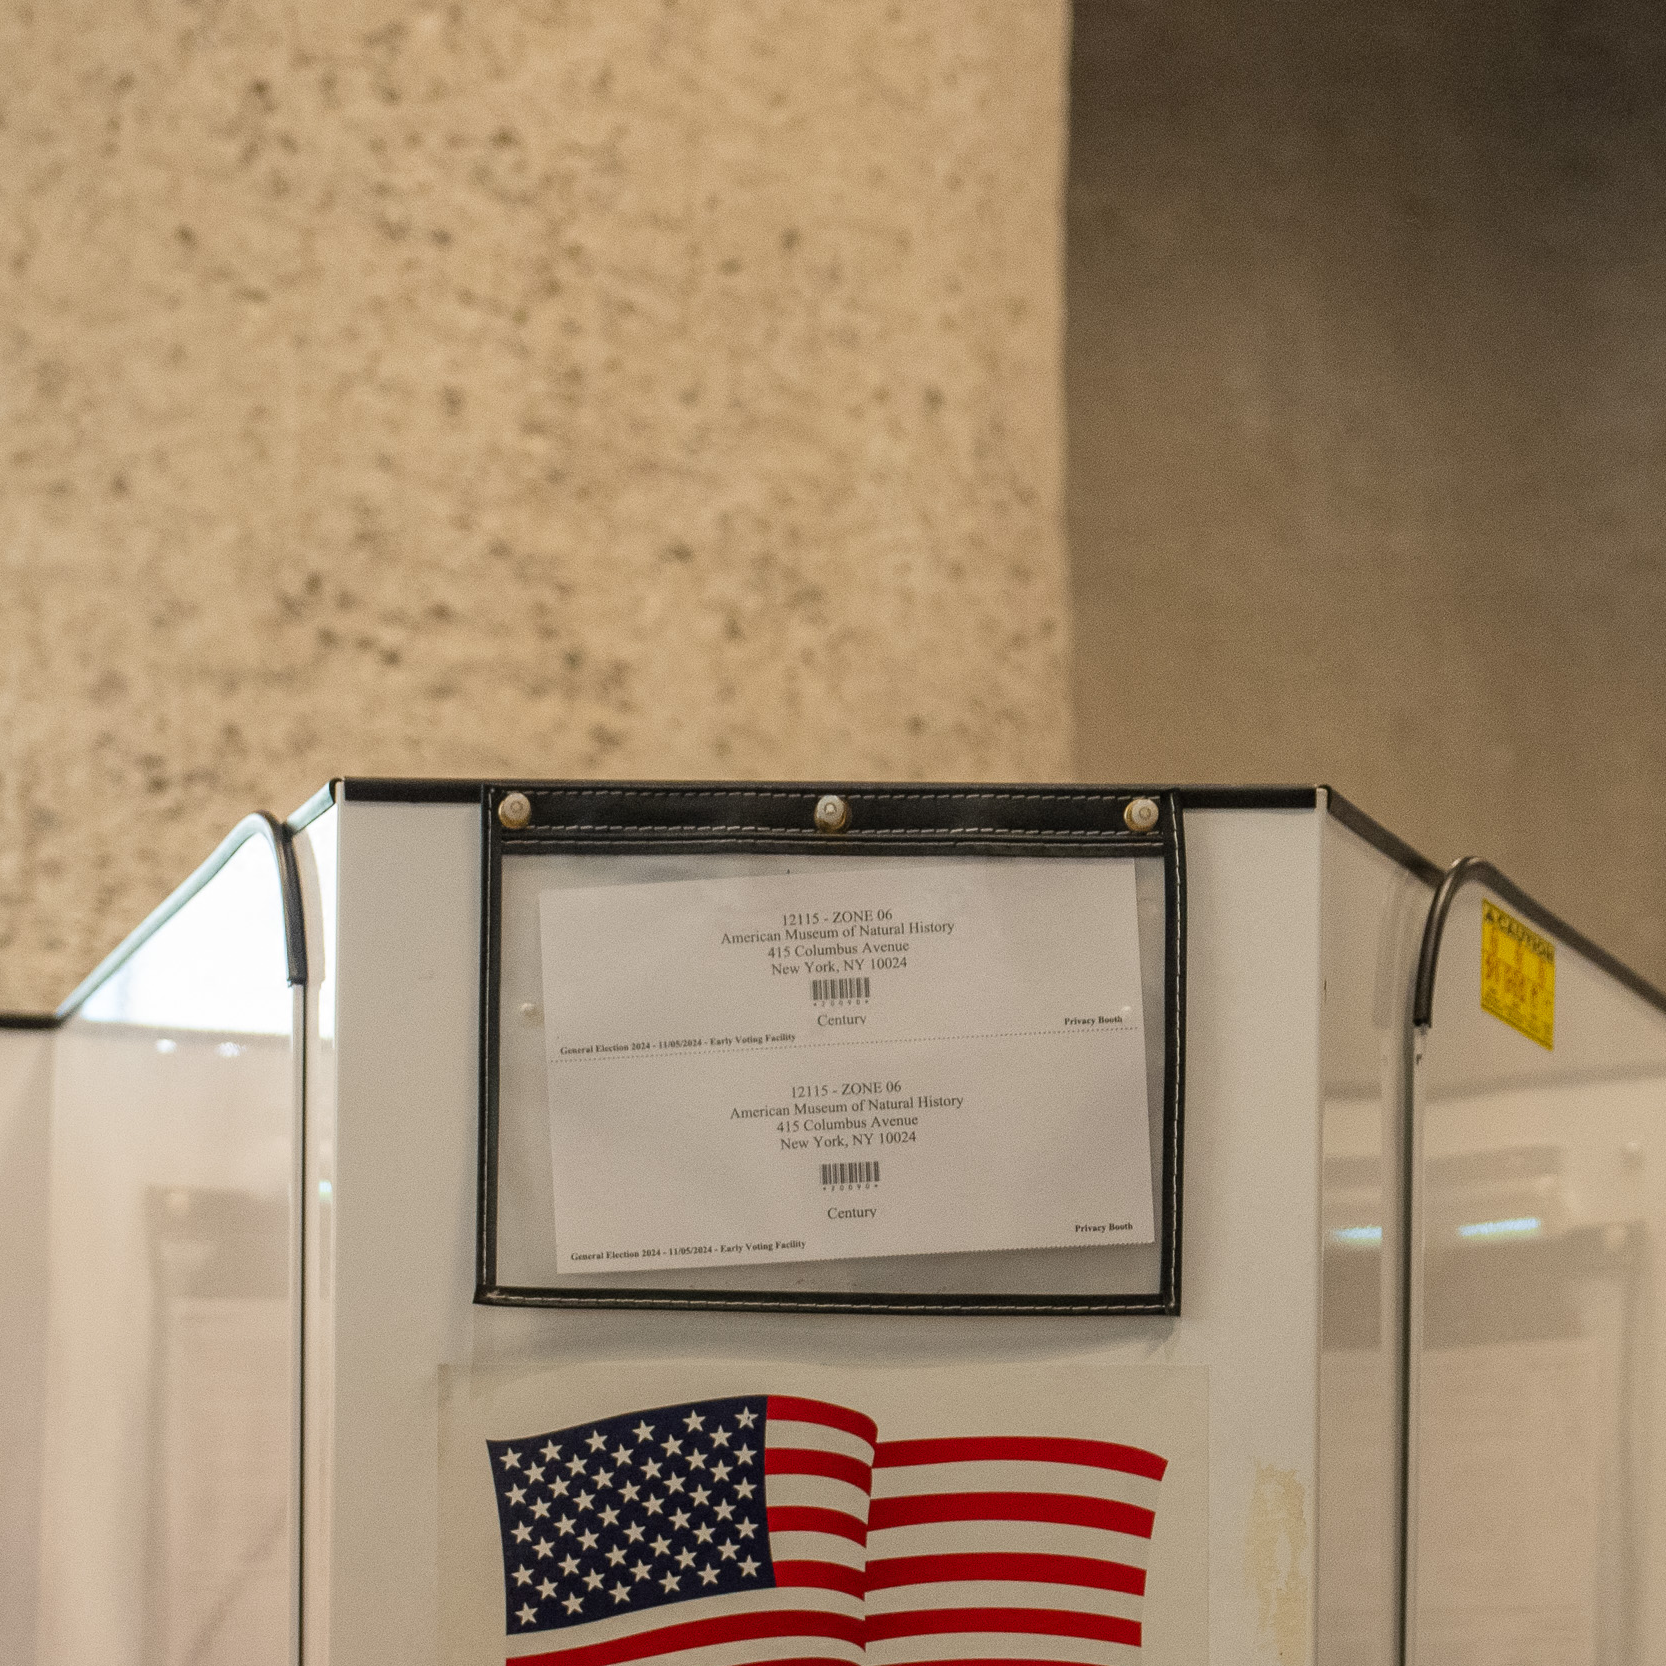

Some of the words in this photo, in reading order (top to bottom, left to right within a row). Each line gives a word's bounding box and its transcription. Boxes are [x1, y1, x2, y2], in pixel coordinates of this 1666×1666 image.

[783, 912, 820, 926] 12115
[833, 910, 873, 924] ZONE
[877, 909, 893, 921] 06
[721, 928, 782, 944] American
[785, 926, 839, 941] Museum
[842, 924, 856, 938] of
[859, 922, 905, 937] Natural
[909, 920, 955, 936] History
[767, 946, 791, 958] 415
[794, 942, 858, 957] Columbus
[861, 940, 909, 954] Avenue
[771, 963, 800, 976] New
[804, 960, 839, 974] York,
[843, 958, 865, 971] NY
[870, 956, 908, 970] 10024
[817, 1014, 867, 1027] Century
[1064, 1017, 1095, 1026] Privacy
[1099, 1016, 1123, 1024] Booth
[560, 1045, 593, 1056] General
[595, 1043, 629, 1053] Election
[631, 1042, 651, 1050] 2024
[659, 1039, 702, 1050] 11/05/2024
[710, 1036, 733, 1048] Early
[735, 1034, 763, 1046] Voting
[765, 1032, 796, 1043] Facility
[791, 1084, 829, 1098] 12115
[841, 1082, 883, 1096] ZONE
[885, 1080, 902, 1093] 06
[731, 1102, 790, 1119] American
[794, 1100, 848, 1114] Museum
[851, 1098, 865, 1112] of
[868, 1096, 914, 1111] Natural
[917, 1094, 964, 1110] History
[777, 1120, 800, 1133] 415
[803, 1116, 867, 1131] Columbus
[871, 1114, 919, 1128] Avenue
[781, 1137, 809, 1150] New
[813, 1134, 849, 1148] York,
[853, 1132, 874, 1146] NY
[879, 1131, 917, 1144] 10024
[827, 1206, 877, 1220] Century
[1075, 1224, 1105, 1233] Privacy
[1109, 1222, 1133, 1231] Booth
[571, 1251, 604, 1261] General
[606, 1250, 639, 1260] Election
[642, 1249, 661, 1258] 2024
[669, 1246, 713, 1256] 11/05/2024
[721, 1244, 743, 1254] Early
[745, 1242, 773, 1252] Voting
[775, 1239, 807, 1250] Facility
